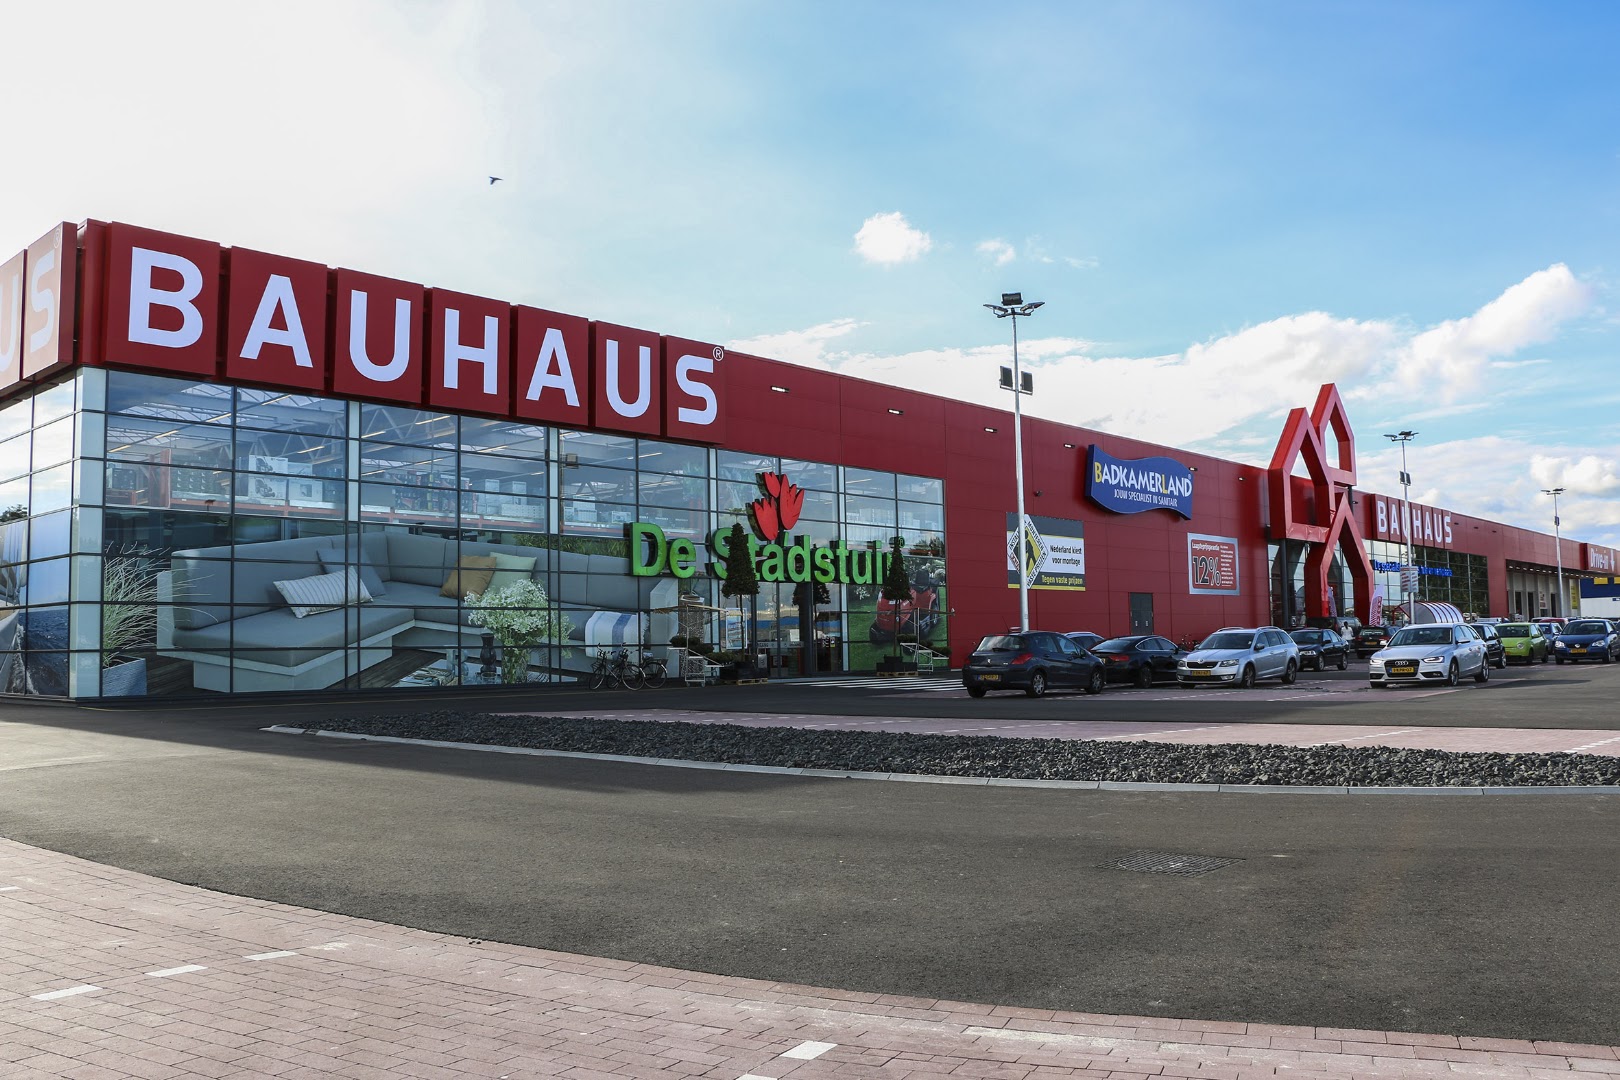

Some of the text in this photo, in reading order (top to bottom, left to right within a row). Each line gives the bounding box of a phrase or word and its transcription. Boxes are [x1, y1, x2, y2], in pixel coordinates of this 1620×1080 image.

[128, 246, 718, 425] BAUHAUS
[1094, 461, 1193, 498] BADKAMERLAND
[1128, 491, 1152, 503] SPECIALIST
[1152, 494, 1158, 504] IN
[1158, 496, 1178, 507] SANITAIR
[1377, 500, 1453, 544] BAUHAUS
[630, 522, 893, 585] De Stadstui
[1050, 545, 1082, 554] Nederland kiest
[1062, 558, 1081, 567] montage
[1041, 575, 1083, 585] Tegen vaste prijzen
[1192, 555, 1221, 586] 12%
